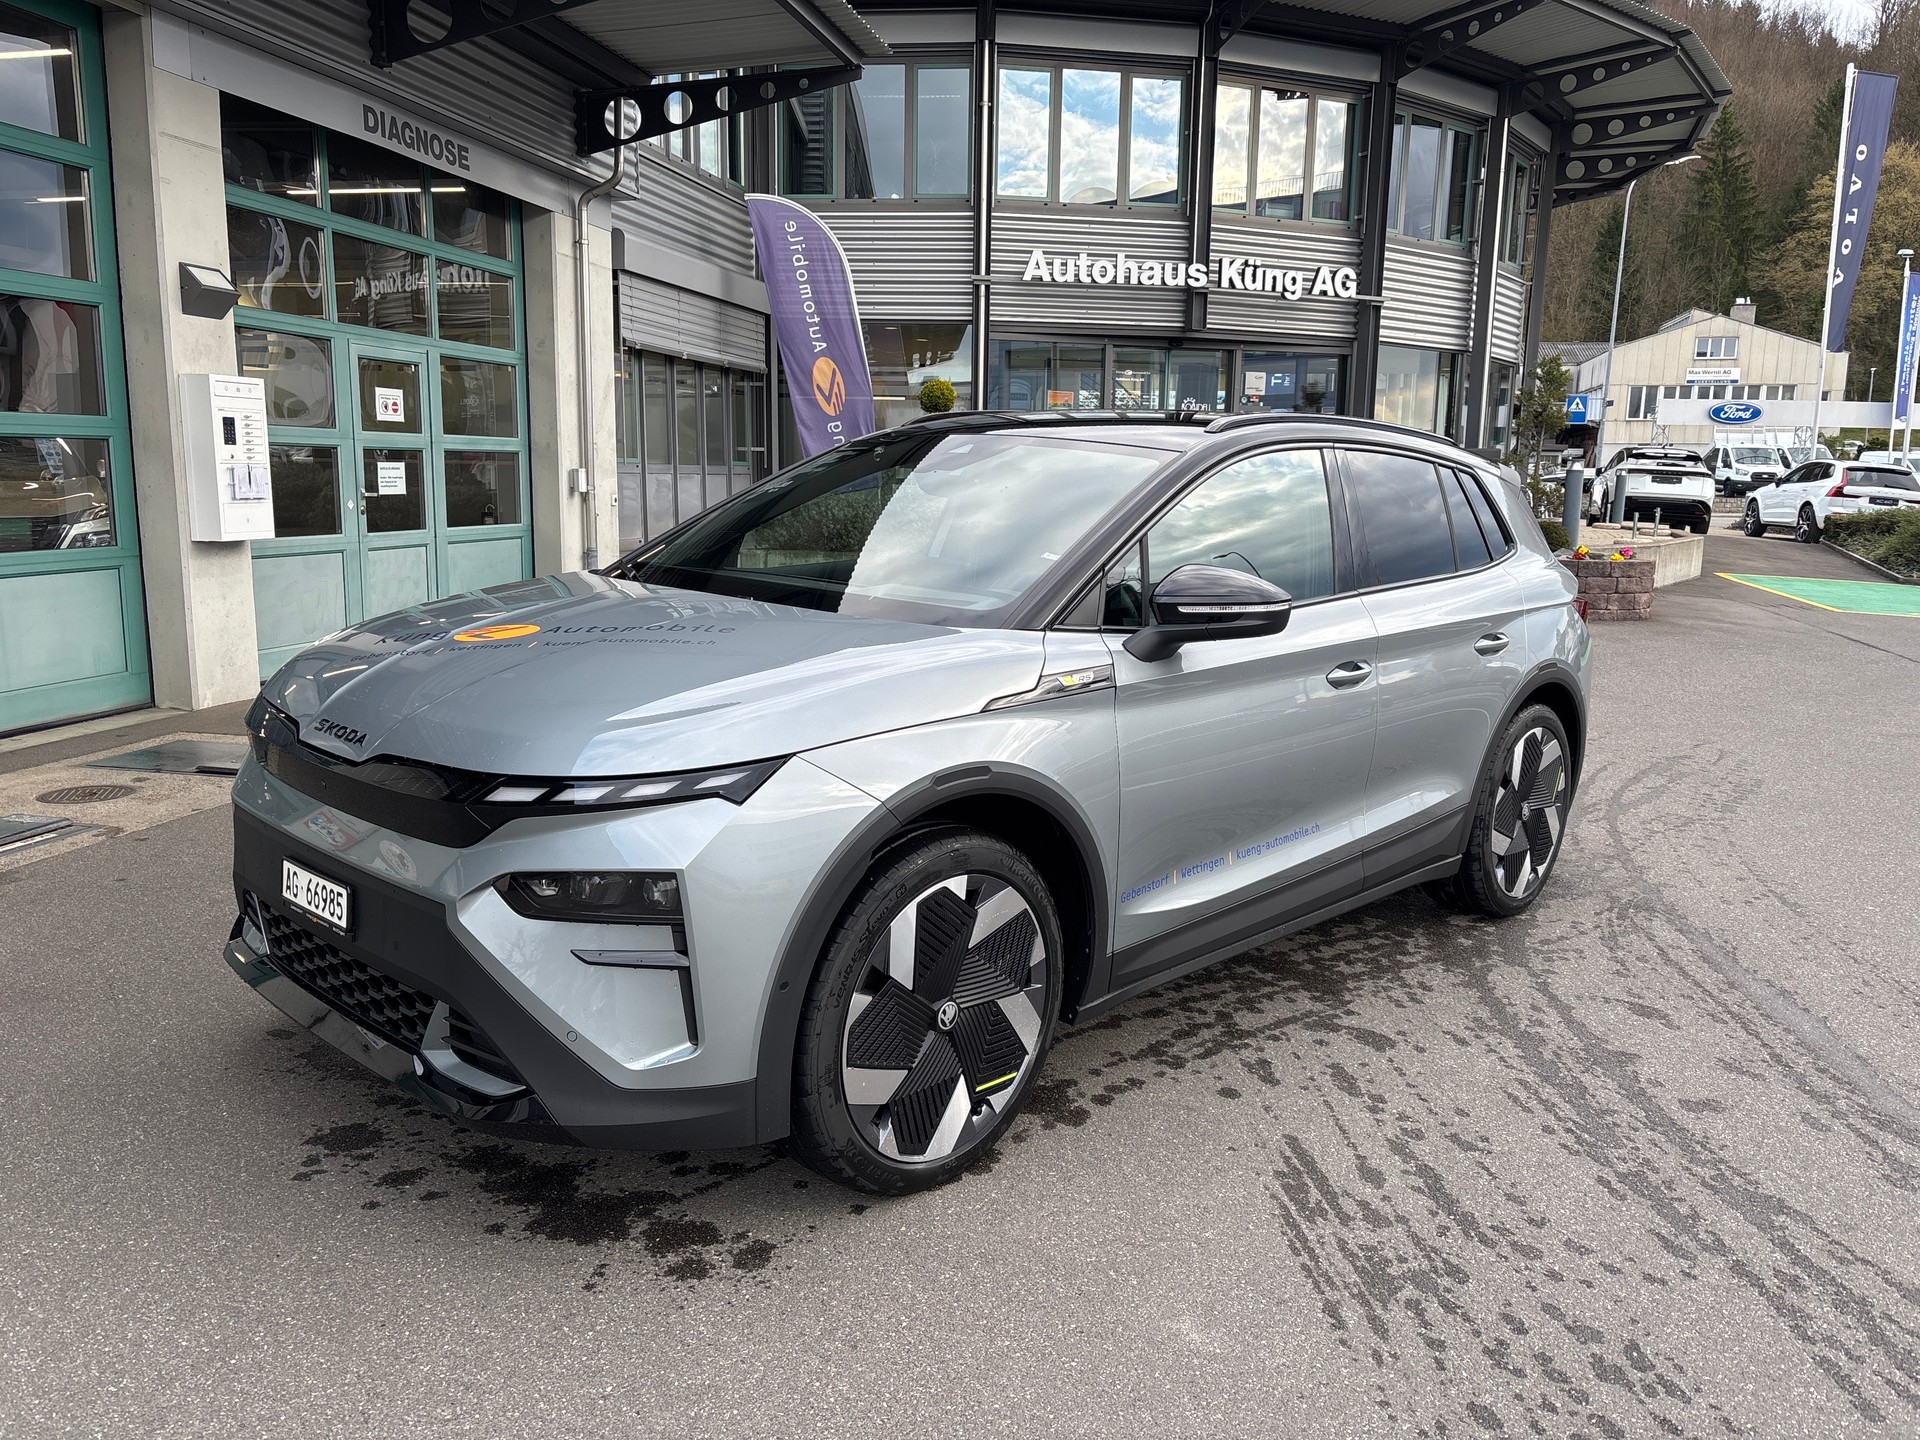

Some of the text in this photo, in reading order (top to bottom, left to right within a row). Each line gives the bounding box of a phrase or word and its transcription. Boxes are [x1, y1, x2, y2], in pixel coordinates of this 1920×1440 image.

[363, 104, 470, 172] DIAGNOSE
[1833, 144, 1868, 288] VOLVO
[1022, 249, 1358, 300] Autohaus Küng AG
[1720, 404, 1754, 419] Ford
[350, 648, 435, 662] Gebenstorf
[448, 642, 522, 652] Wettingen
[373, 623, 736, 645] Küng Automobile
[1078, 674, 1091, 682] RS
[1120, 822, 1320, 904] Gebenstorf Wettingen kueng-automobile.ch
[285, 866, 343, 921] AG 66985
